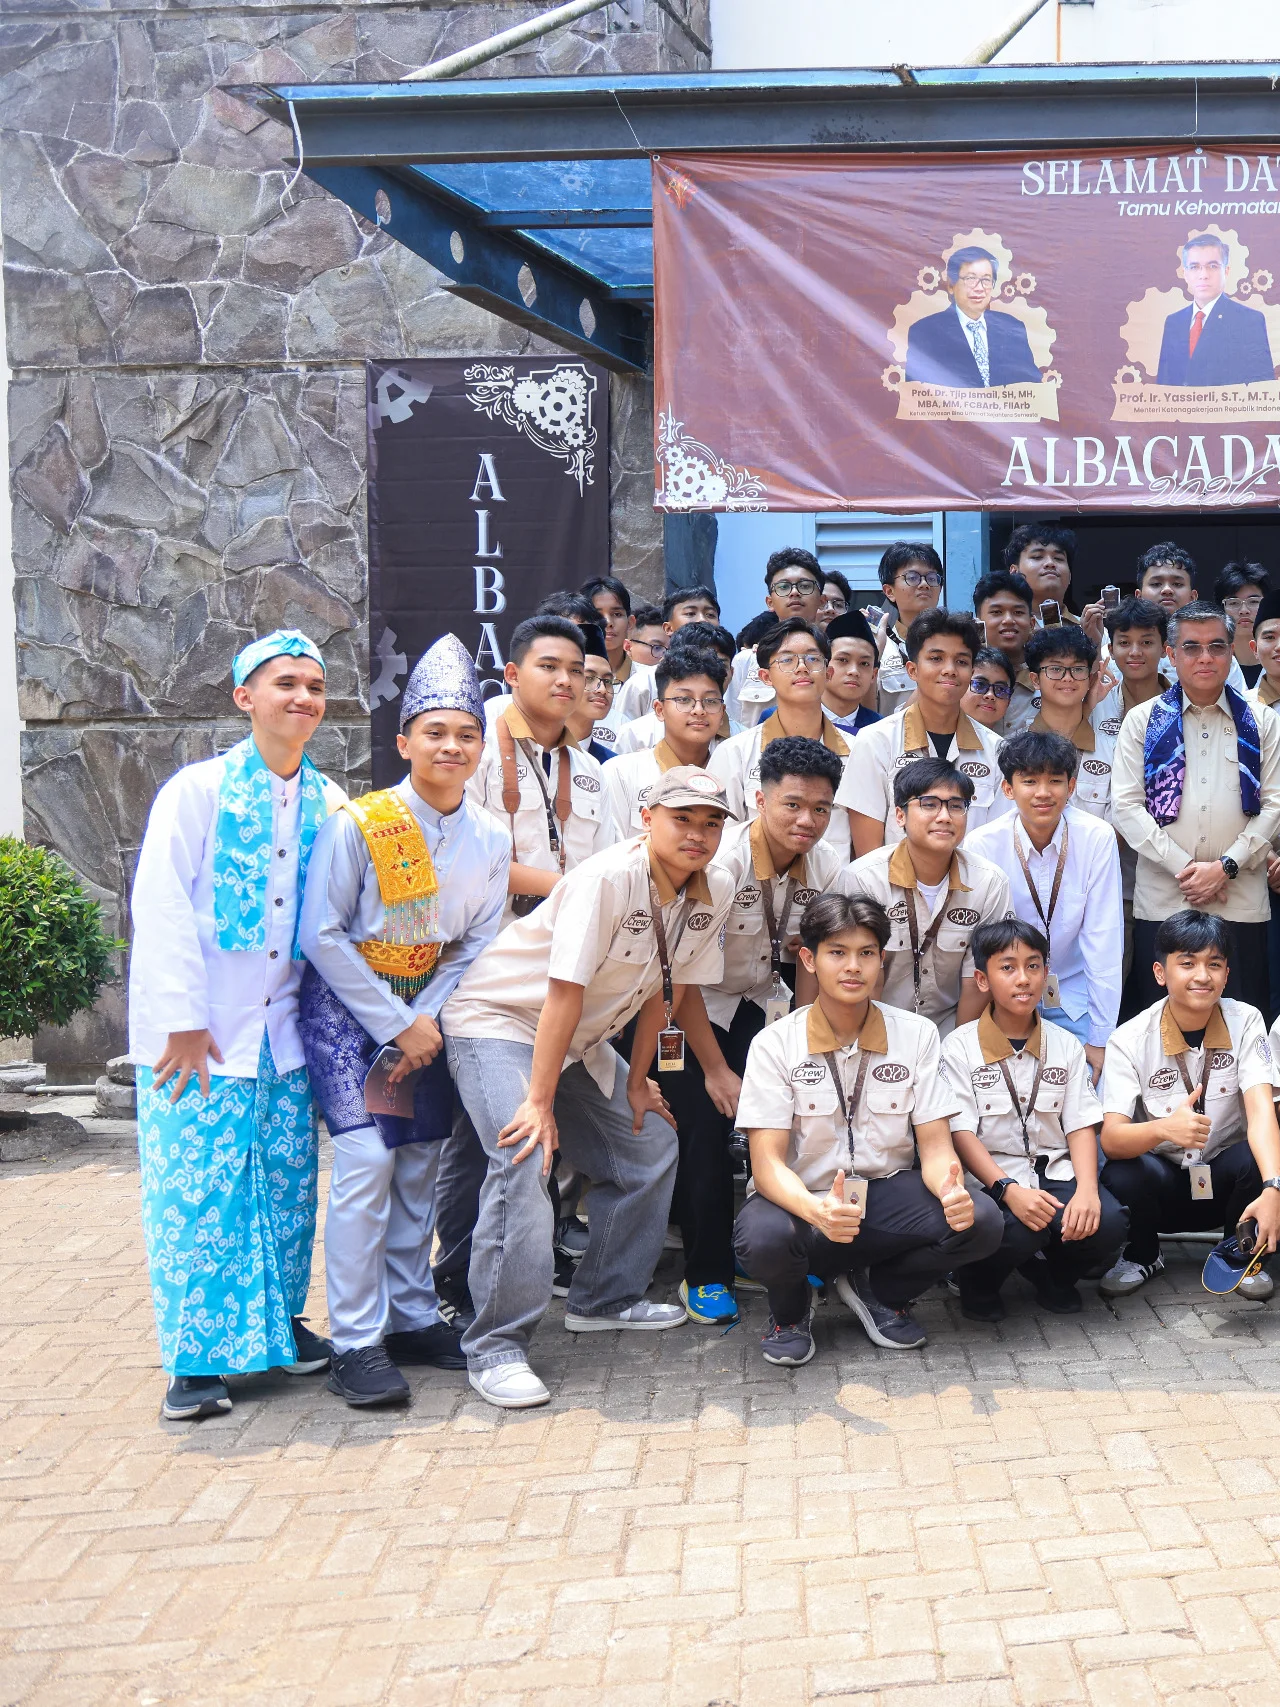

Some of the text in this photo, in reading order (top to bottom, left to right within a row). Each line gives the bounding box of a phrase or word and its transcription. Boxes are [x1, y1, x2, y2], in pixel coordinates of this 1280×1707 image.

[1021, 156, 1206, 196] SELAMAT
[1117, 201, 1171, 217] Tamu
[911, 389, 1036, 400] Prof. Dr. Tjip Ismail, SH, MH,
[1119, 393, 1147, 403] Prof.
[1149, 393, 1161, 403] Ir.
[1163, 392, 1218, 404] Yassierli,
[1221, 392, 1245, 403] S.T.,
[1247, 391, 1276, 403] M.T.,
[917, 400, 941, 409] MBA,
[942, 400, 962, 409] MM,
[1224, 405, 1255, 414] Republik
[1132, 464, 1277, 507] 2026
[1211, 1053, 1233, 1069] 026
[1042, 1068, 1068, 1085] 202
